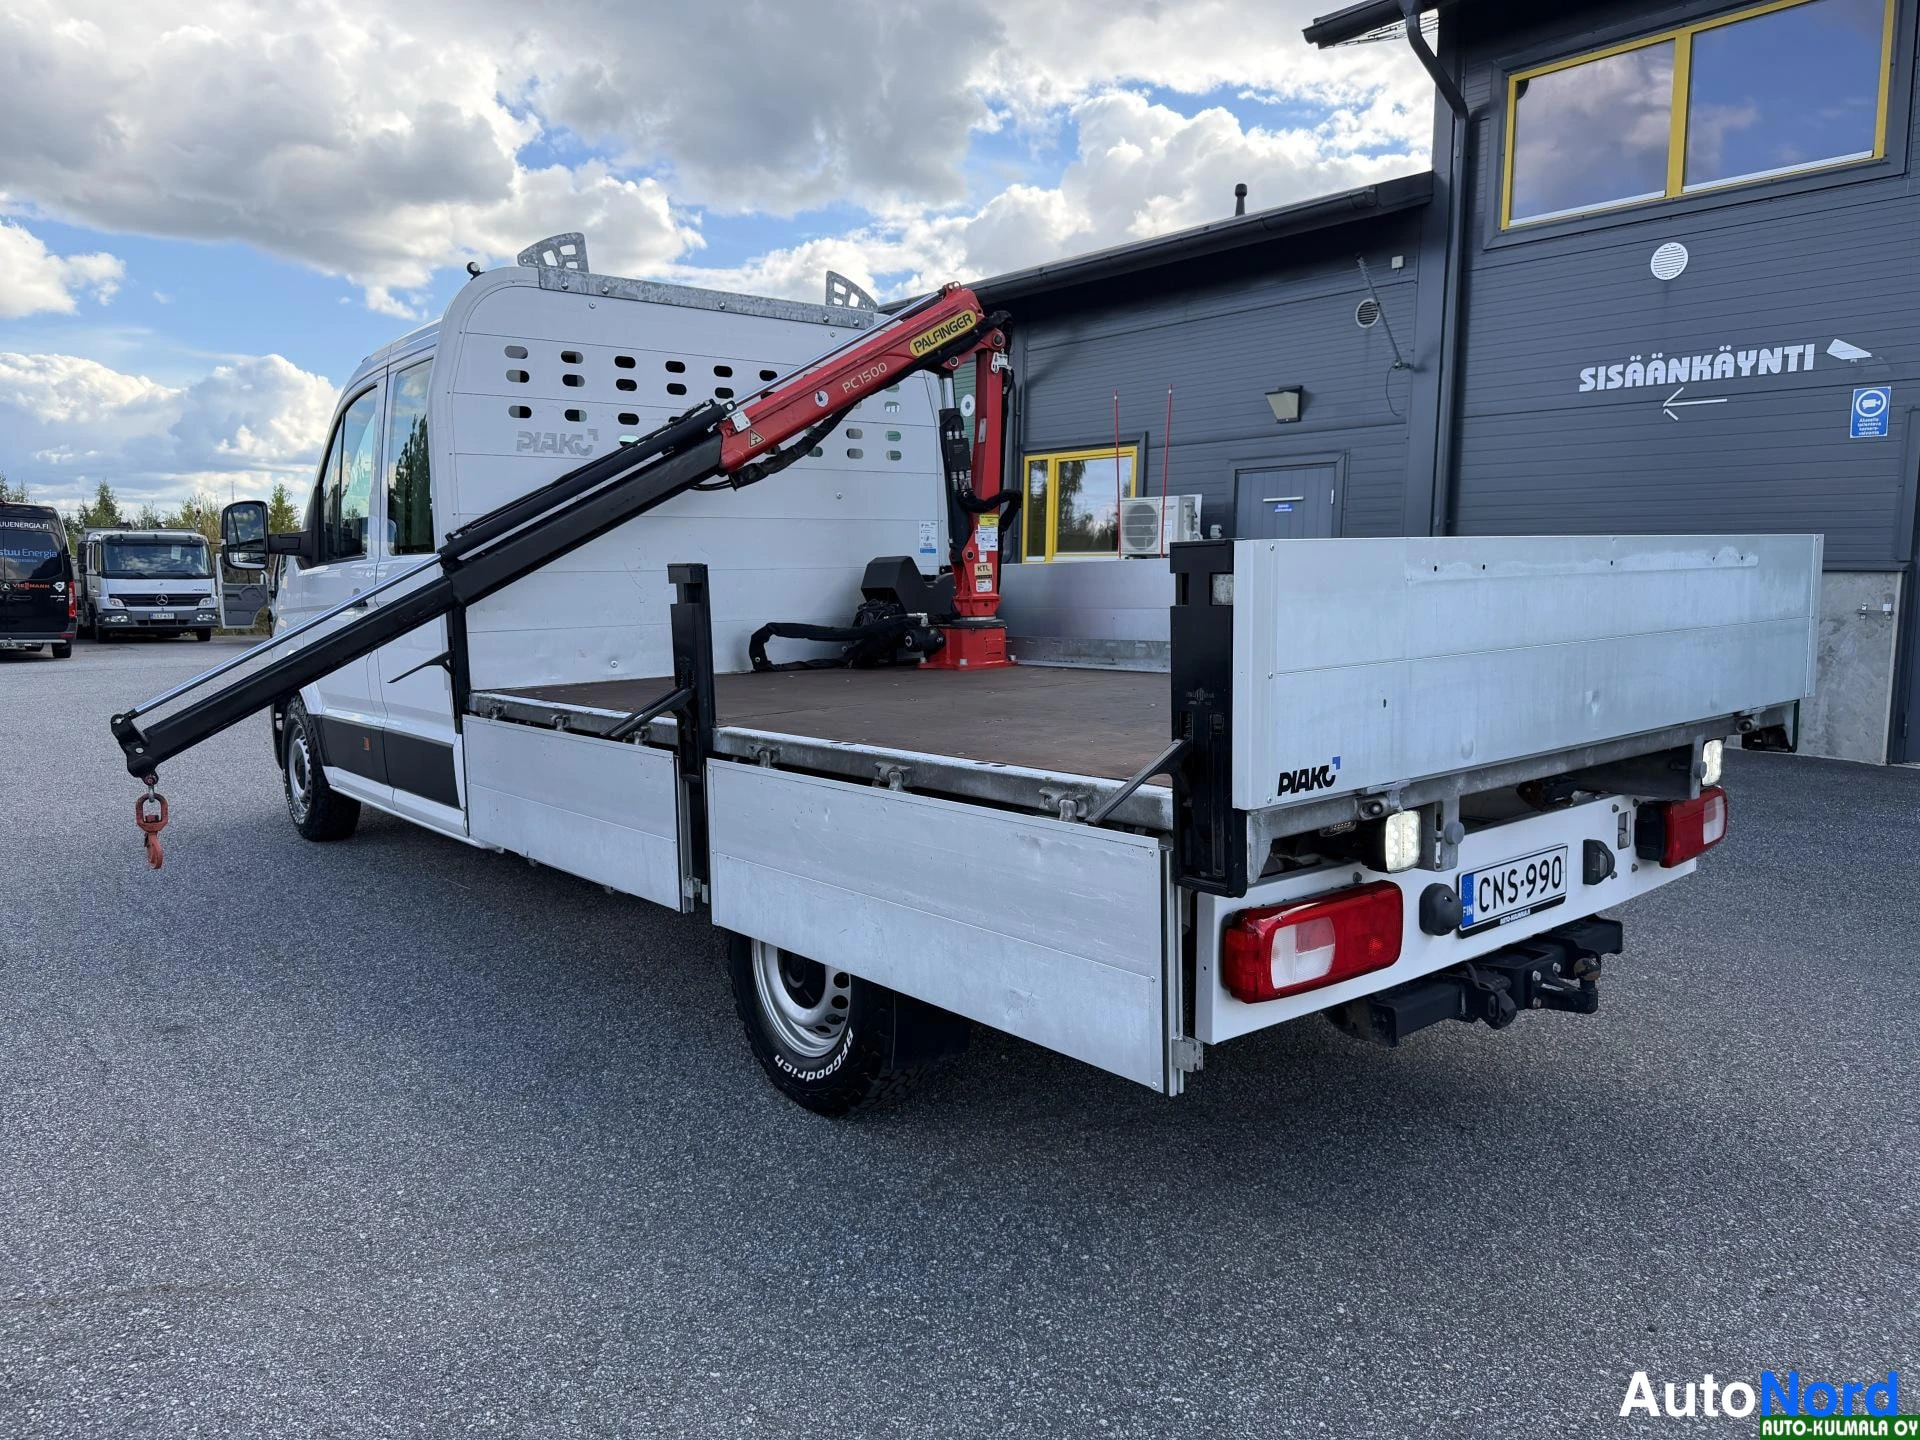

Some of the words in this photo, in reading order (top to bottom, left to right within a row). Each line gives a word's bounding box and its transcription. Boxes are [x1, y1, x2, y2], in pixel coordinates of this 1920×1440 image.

[912, 313, 974, 354] PALFINGER
[841, 361, 888, 394] PC1500
[1578, 343, 1816, 392] SISÄÄNKÄYNTI
[22, 549, 58, 560] Energia
[1479, 855, 1562, 913] CNS-990
[1462, 904, 1474, 918] FIN
[774, 1026, 854, 1082] BFGoodrich
